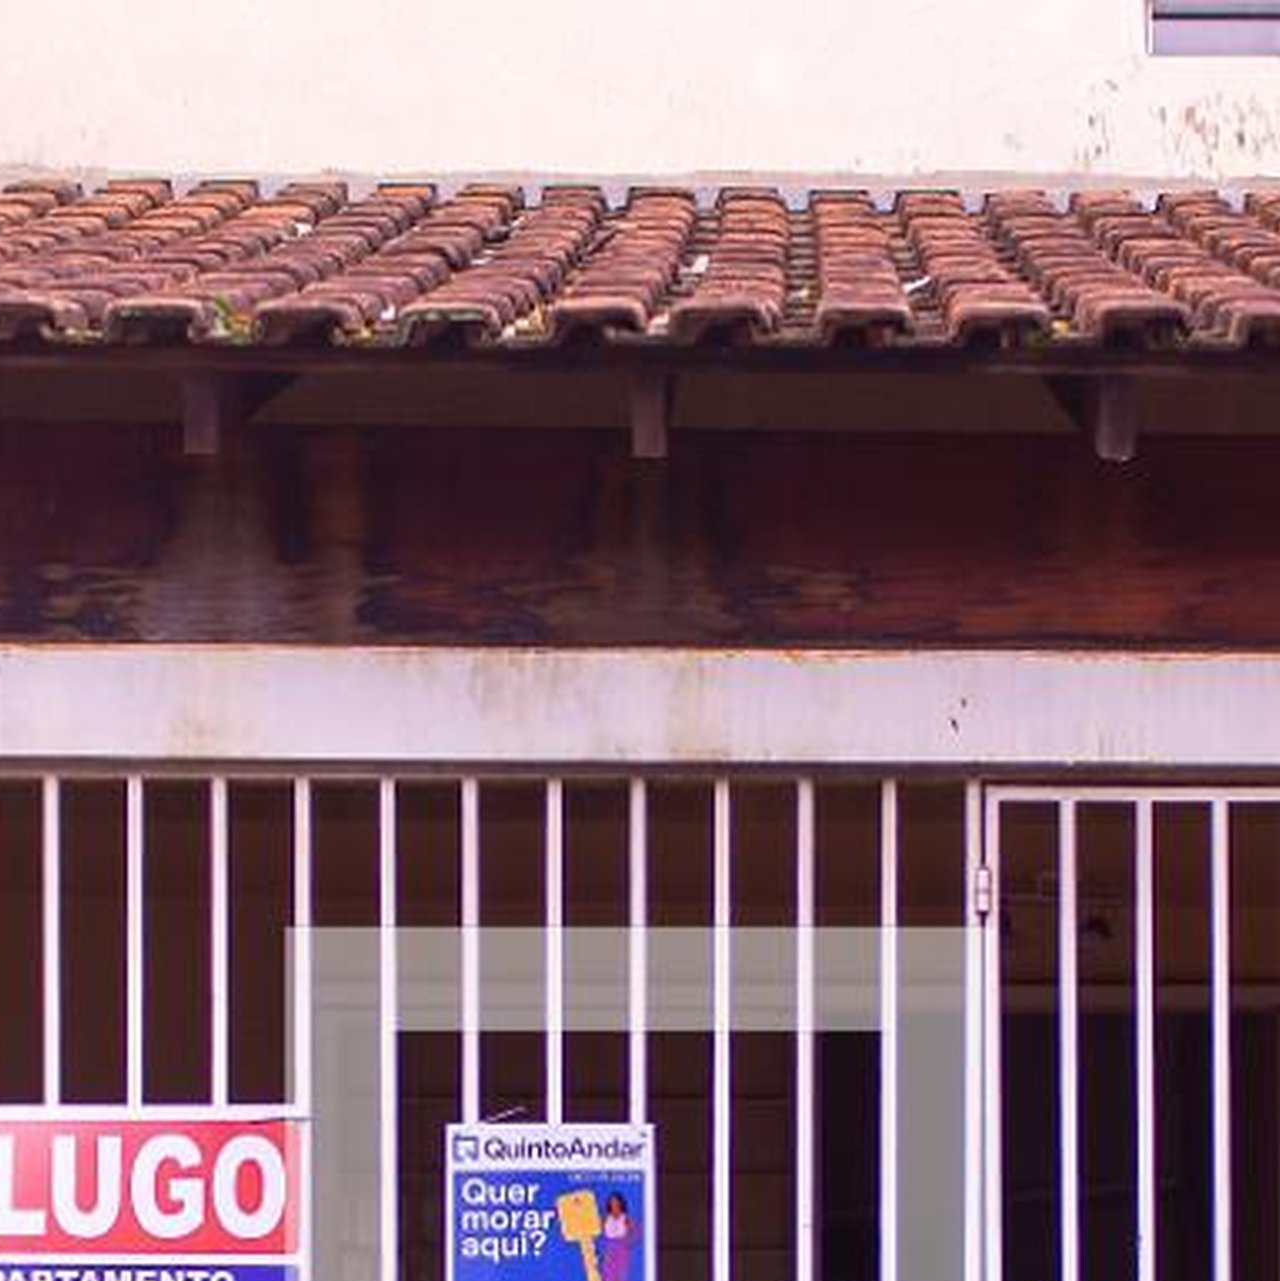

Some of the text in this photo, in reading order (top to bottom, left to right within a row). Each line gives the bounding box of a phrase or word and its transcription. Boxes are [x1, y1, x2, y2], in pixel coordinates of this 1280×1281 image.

[483, 1137, 646, 1161] QuintoAndar
[461, 1179, 539, 1205] Quer
[461, 1210, 555, 1230] morar
[461, 1231, 546, 1262] aqui?
